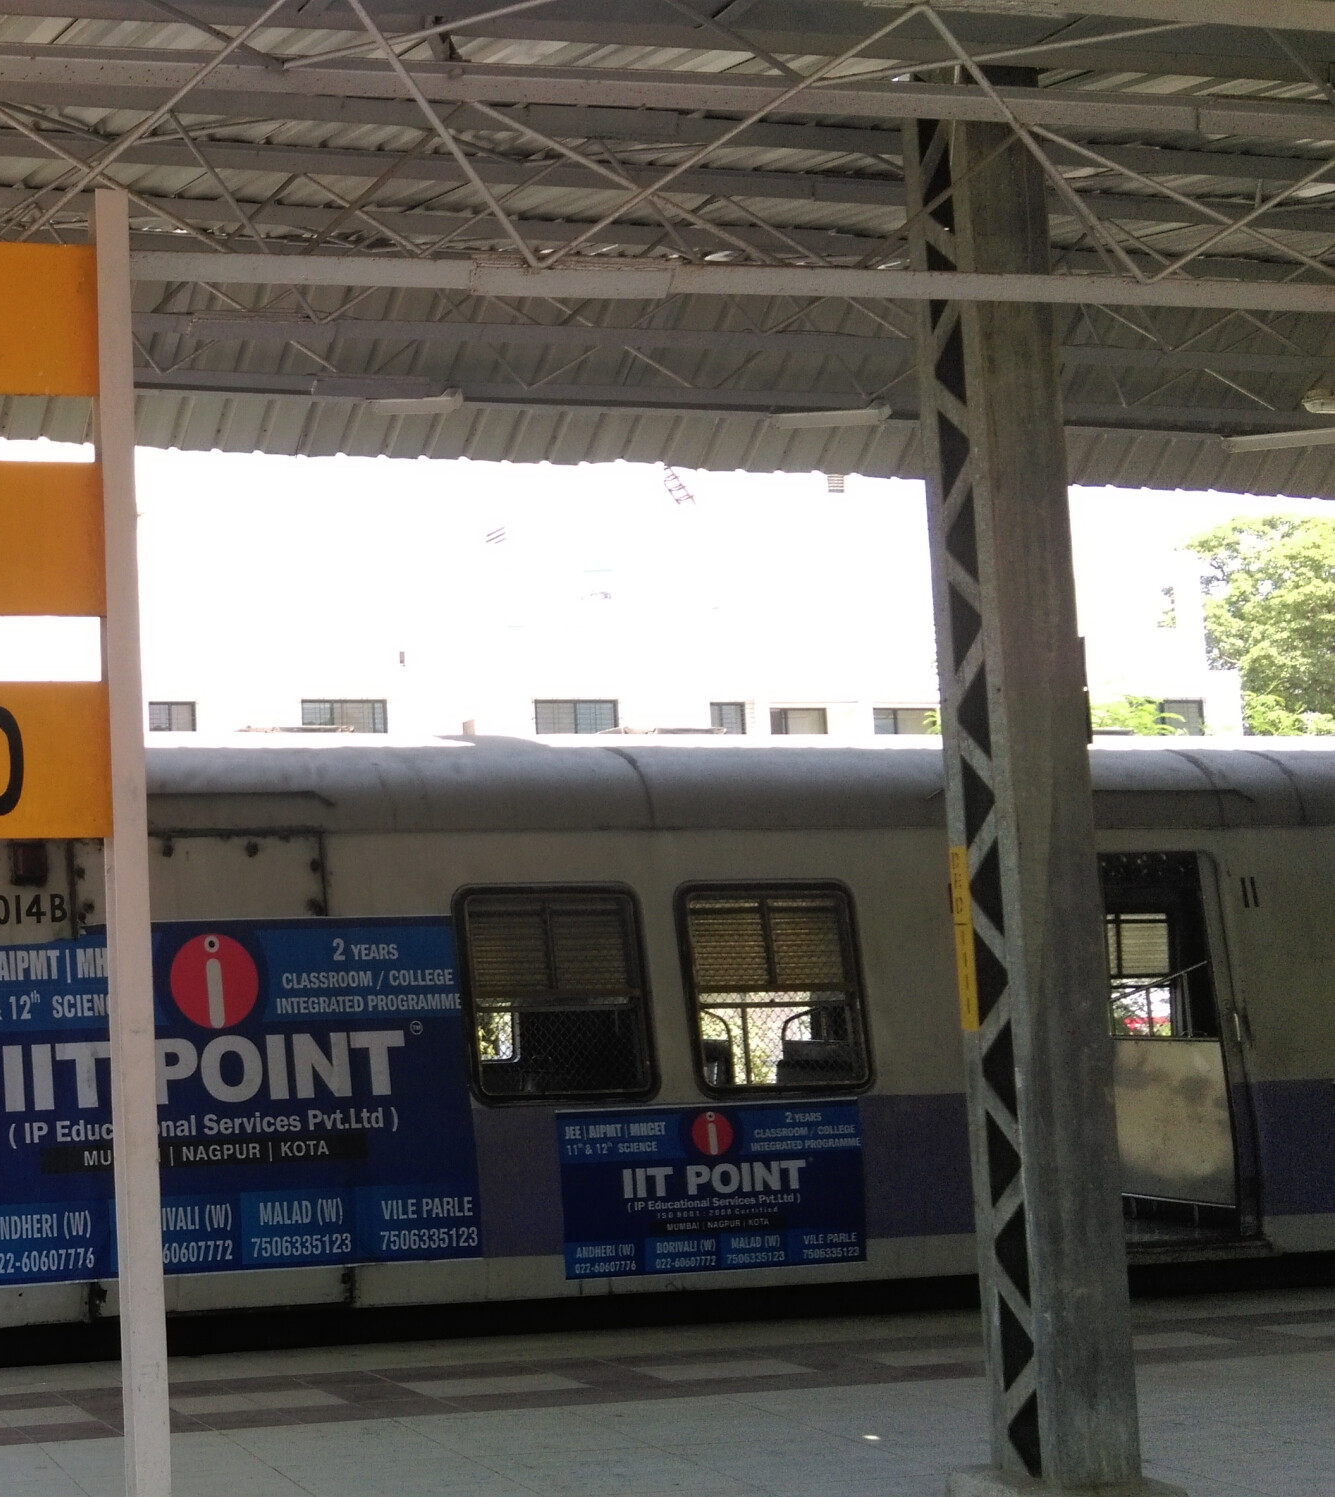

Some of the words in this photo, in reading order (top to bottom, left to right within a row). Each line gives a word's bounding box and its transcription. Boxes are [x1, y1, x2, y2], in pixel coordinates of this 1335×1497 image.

[333, 938, 345, 961] 2
[352, 944, 399, 960] YEARS
[282, 971, 373, 989] CLASSROOM
[389, 969, 454, 986] COLLEGE
[52, 994, 109, 1019] SCIEN
[276, 996, 363, 1014] INTEGRATED
[368, 993, 461, 1013] PROGRAMME
[2, 1041, 111, 1112] IIT
[155, 1030, 405, 1105] POINT
[203, 1111, 301, 1135] Services
[785, 1112, 793, 1123] 2
[795, 1112, 822, 1122] YEARS
[565, 1125, 581, 1139] JEE
[589, 1124, 622, 1138] AIPMT
[754, 1126, 808, 1138] CLASSROOM
[817, 1125, 856, 1135] COLLEGE
[182, 1143, 261, 1161] NAGPUR
[280, 1140, 329, 1157] KOTA
[618, 1141, 658, 1153] SCIENCE
[751, 1140, 803, 1152] INTEGRATED
[805, 1137, 862, 1149] PROGRAMME
[622, 1166, 674, 1199] IIT
[686, 1159, 806, 1196] POINT
[259, 1201, 312, 1226] MALAD
[317, 1197, 343, 1226] (W)
[381, 1199, 417, 1220] VILE
[422, 1197, 473, 1218] PARLE
[648, 1198, 710, 1210] Educational
[714, 1195, 756, 1206] Services
[64, 1210, 91, 1239] (W)
[205, 1203, 232, 1231] (W)
[667, 1222, 700, 1231] MUMBAI
[707, 1219, 741, 1229] NAGPUR
[748, 1218, 769, 1226] KOTA
[251, 1233, 352, 1258] 7506335123
[380, 1227, 478, 1251] 7506335123
[656, 1240, 697, 1254] BORIVALI
[731, 1236, 762, 1249] MALAD
[764, 1234, 780, 1247] (W)
[804, 1234, 825, 1245] VILE
[827, 1232, 857, 1244] PARLE
[576, 1245, 616, 1259] ANDHERI
[619, 1243, 635, 1257] (W)
[727, 1251, 785, 1264] 7506335123
